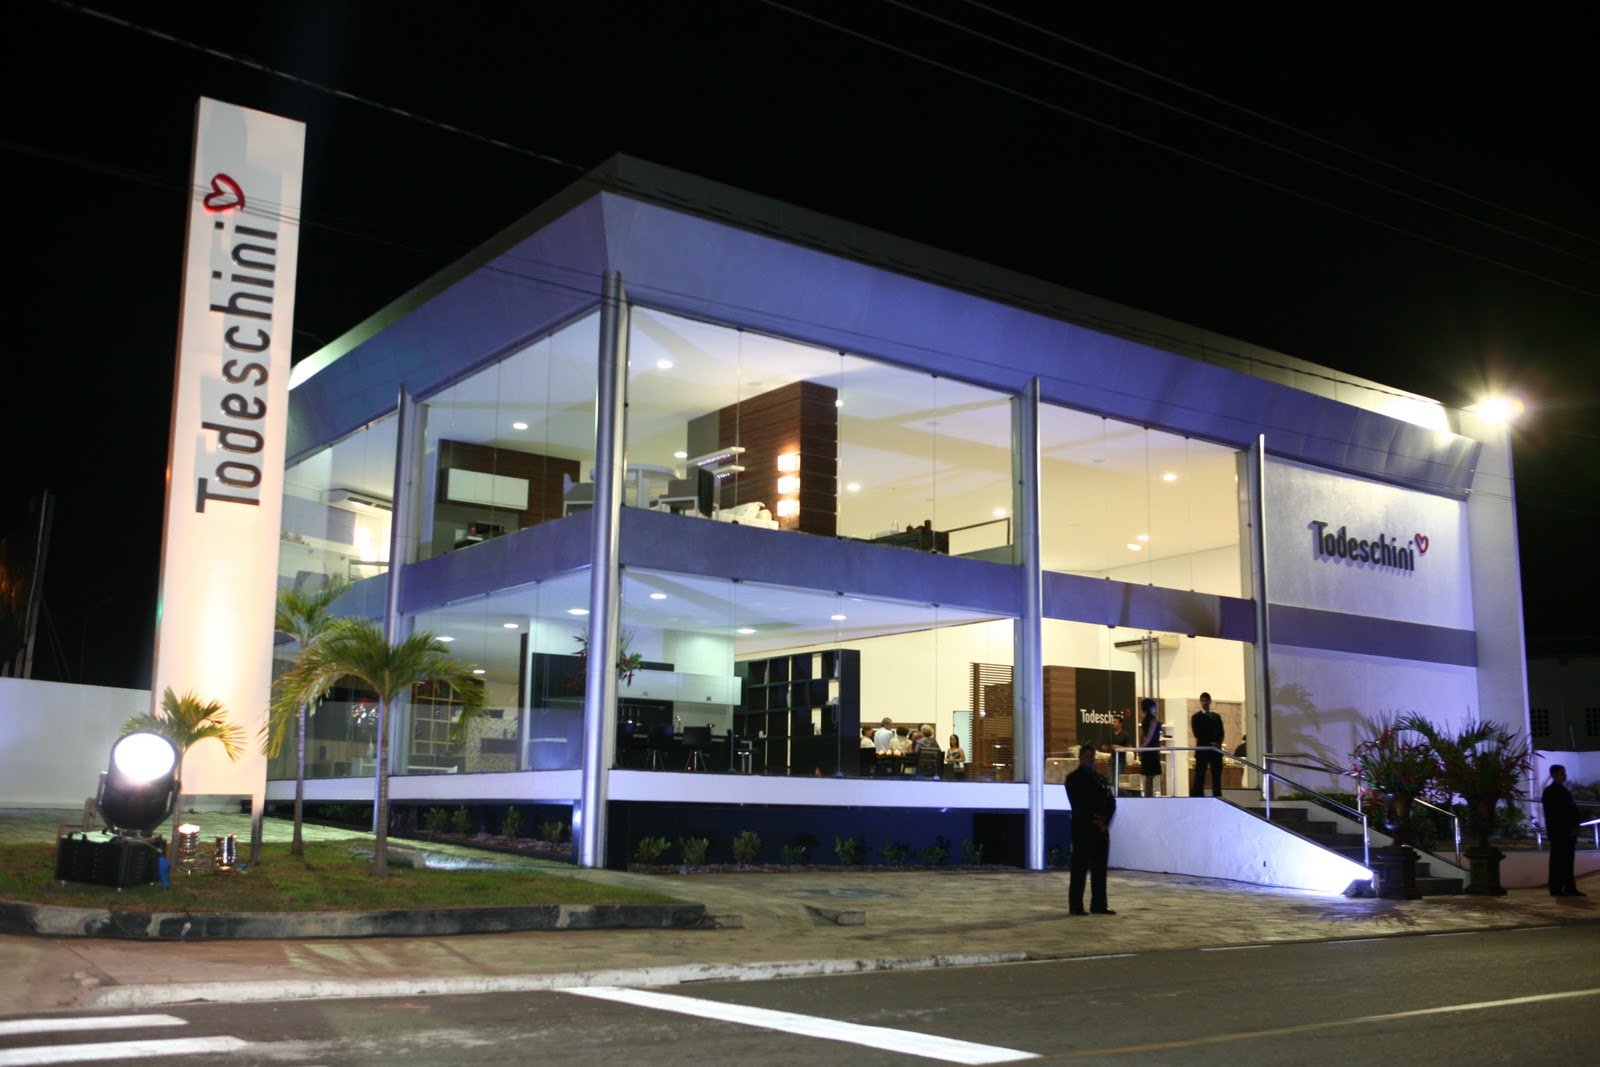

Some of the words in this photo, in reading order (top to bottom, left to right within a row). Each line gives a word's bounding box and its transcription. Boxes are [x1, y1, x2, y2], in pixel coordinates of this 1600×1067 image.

[195, 220, 278, 513] Todeschini
[1311, 520, 1415, 571] Todeschini
[1080, 708, 1124, 725] Todesch
